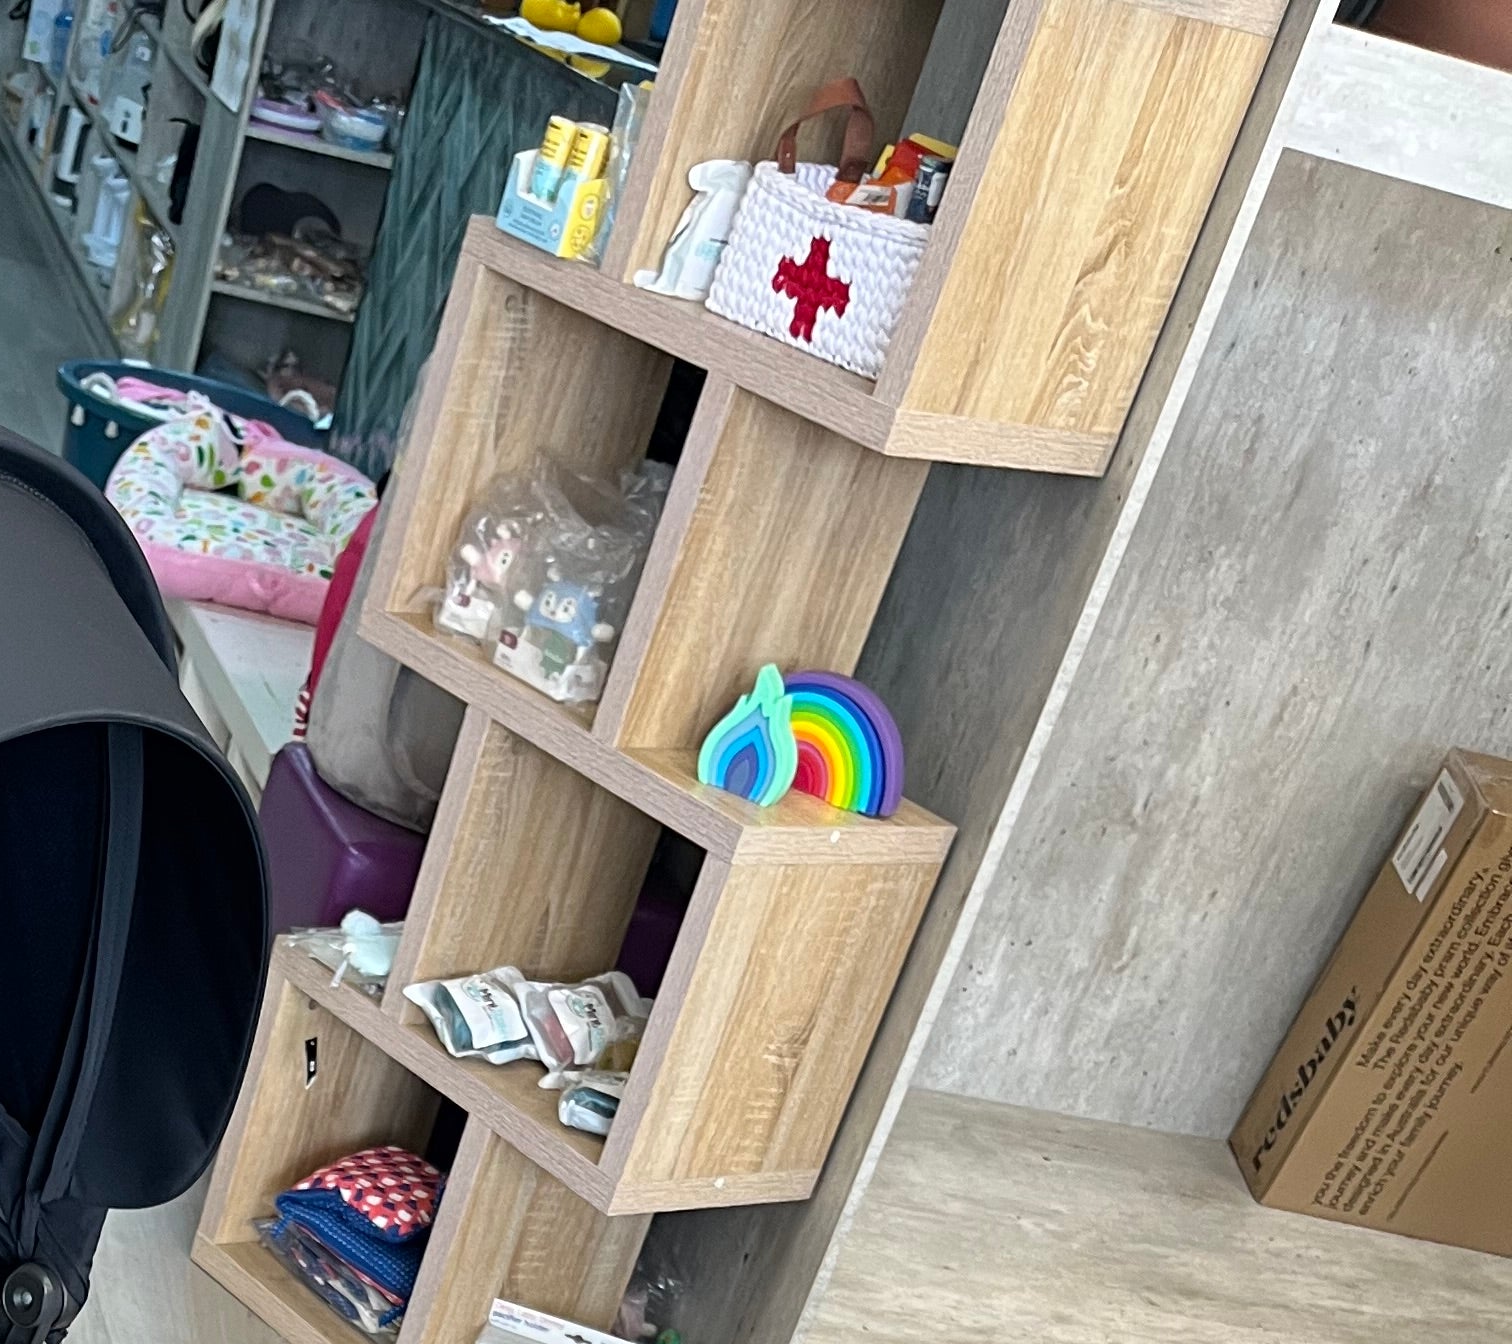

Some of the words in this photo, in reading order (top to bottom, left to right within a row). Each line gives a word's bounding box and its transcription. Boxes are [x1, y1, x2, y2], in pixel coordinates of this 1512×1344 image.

[1355, 1032, 1386, 1068] Make
[1382, 992, 1412, 1029] every
[1406, 965, 1428, 990] day
[1372, 1047, 1395, 1070] The
[1433, 942, 1461, 978] pram
[1457, 874, 1502, 939] collection
[1252, 985, 1357, 1172] redsbaby
[1311, 1182, 1330, 1205] you
[1325, 1161, 1344, 1180] the
[1337, 1108, 1378, 1159] freedom
[1372, 1092, 1387, 1105] to
[1383, 1043, 1418, 1090] explore
[1413, 1012, 1435, 1041] your
[1432, 982, 1454, 1010] new
[1324, 1164, 1362, 1210] journey
[1357, 1139, 1376, 1162] and
[1372, 1104, 1399, 1137] make
[1396, 1066, 1424, 1100] every
[1419, 1040, 1439, 1064] day
[1343, 1157, 1383, 1212] designed
[1377, 1144, 1392, 1155] in
[1386, 1090, 1427, 1142] Australia
[1420, 1068, 1440, 1085] for
[1436, 1044, 1453, 1066] our
[1449, 997, 1483, 1042] unique
[1479, 968, 1503, 995] way
[1498, 952, 1511, 966] of
[1383, 1149, 1405, 1177] your
[1399, 1111, 1432, 1147] family
